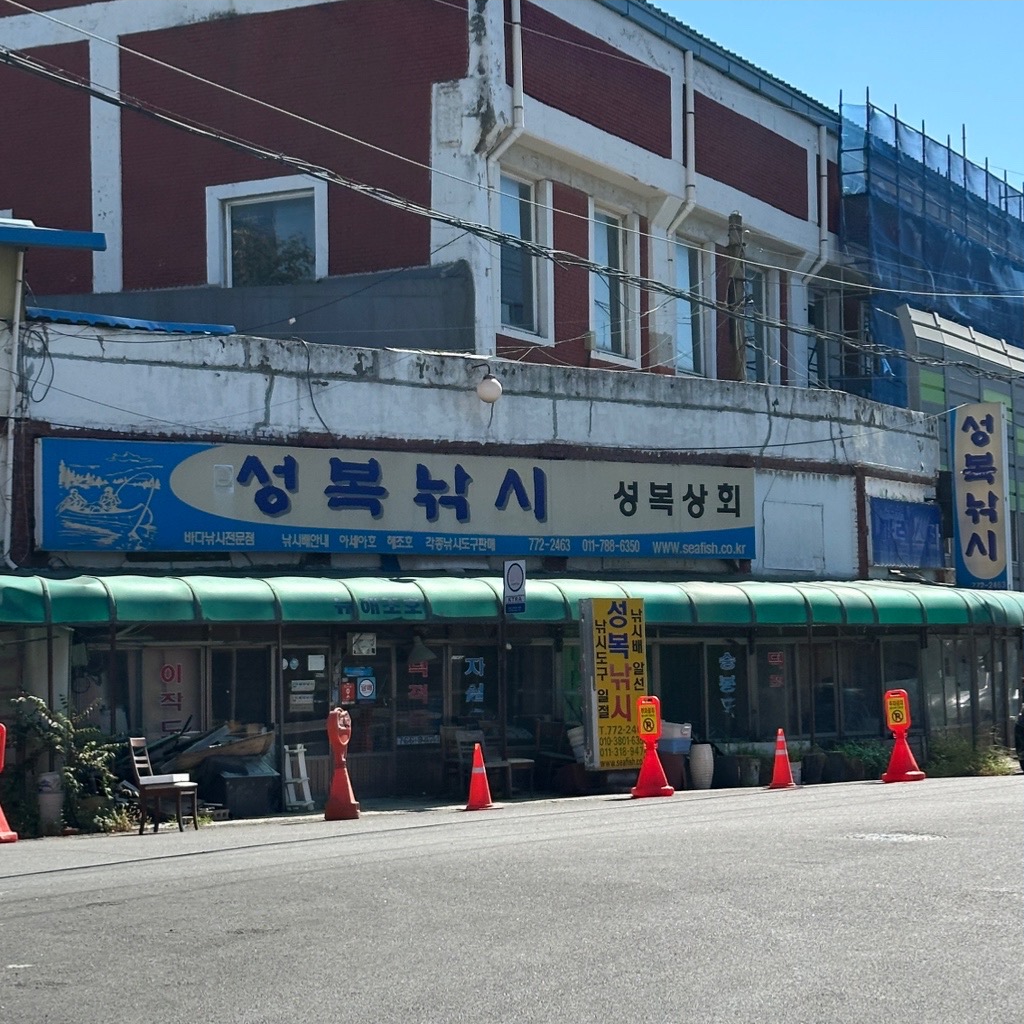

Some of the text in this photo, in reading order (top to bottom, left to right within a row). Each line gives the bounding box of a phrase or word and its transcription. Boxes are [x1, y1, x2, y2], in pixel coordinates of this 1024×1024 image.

[236, 454, 742, 524] 성복낚시 성복상회
[961, 413, 999, 562] 성복낚시
[184, 531, 256, 546] 바다낚시전문점
[425, 535, 496, 552] 각종낚시도구판매
[528, 537, 571, 552] 772-2463
[581, 538, 641, 553] 011-788-6350
[594, 619, 608, 682] 낚시도구
[607, 600, 633, 722] 성복낚시
[630, 608, 645, 692] 낚시배 알선
[599, 725, 638, 736] T.772-24
[600, 747, 644, 757] 011-318-947
